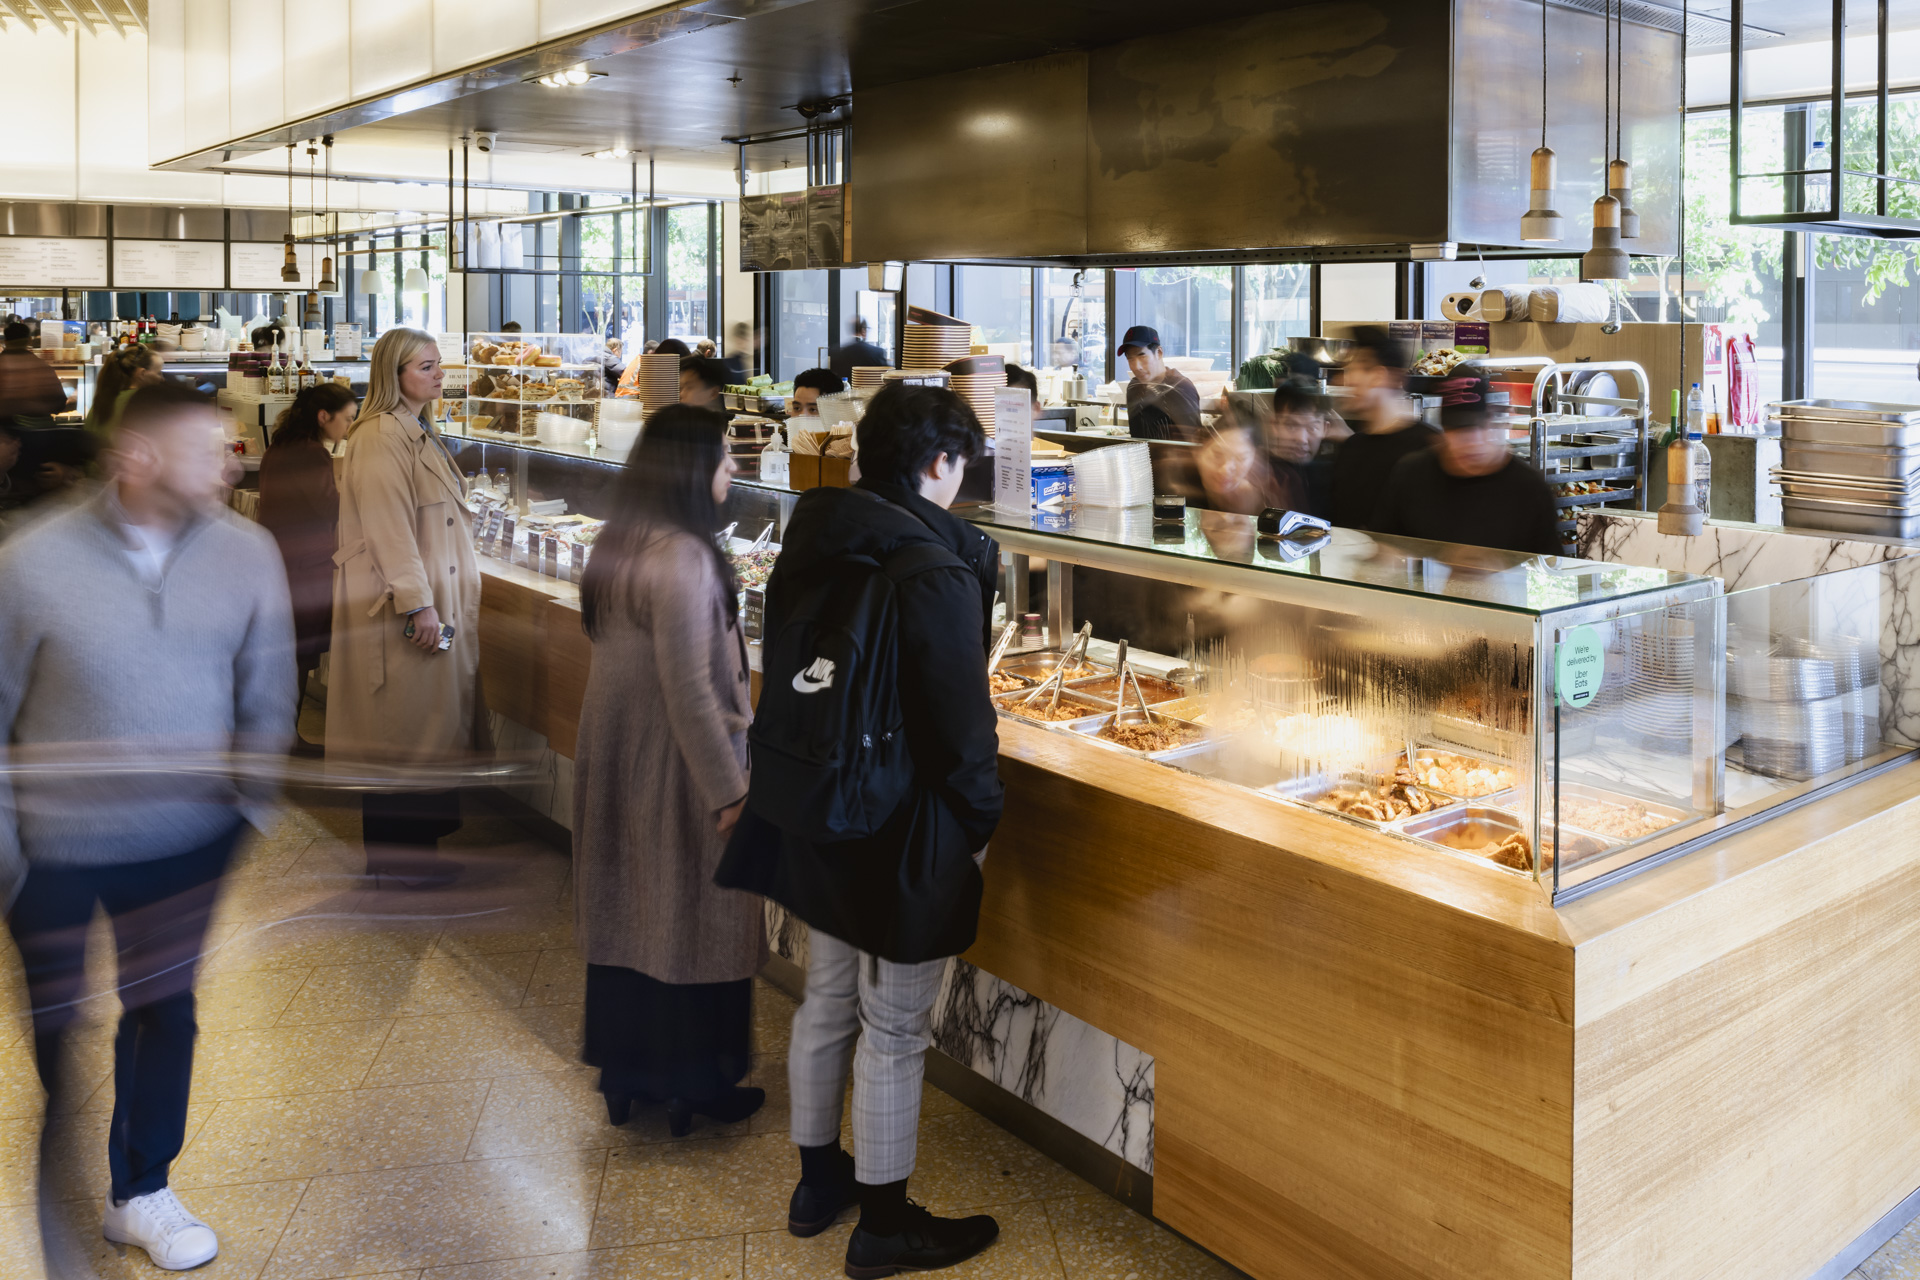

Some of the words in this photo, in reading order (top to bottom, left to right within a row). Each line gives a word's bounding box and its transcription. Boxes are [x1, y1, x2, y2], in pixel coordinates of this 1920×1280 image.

[1574, 645, 1589, 655] We're
[1566, 655, 1590, 667] delivered
[1590, 654, 1598, 664] by
[1574, 670, 1588, 680] Uber
[1574, 679, 1588, 689] Eats
